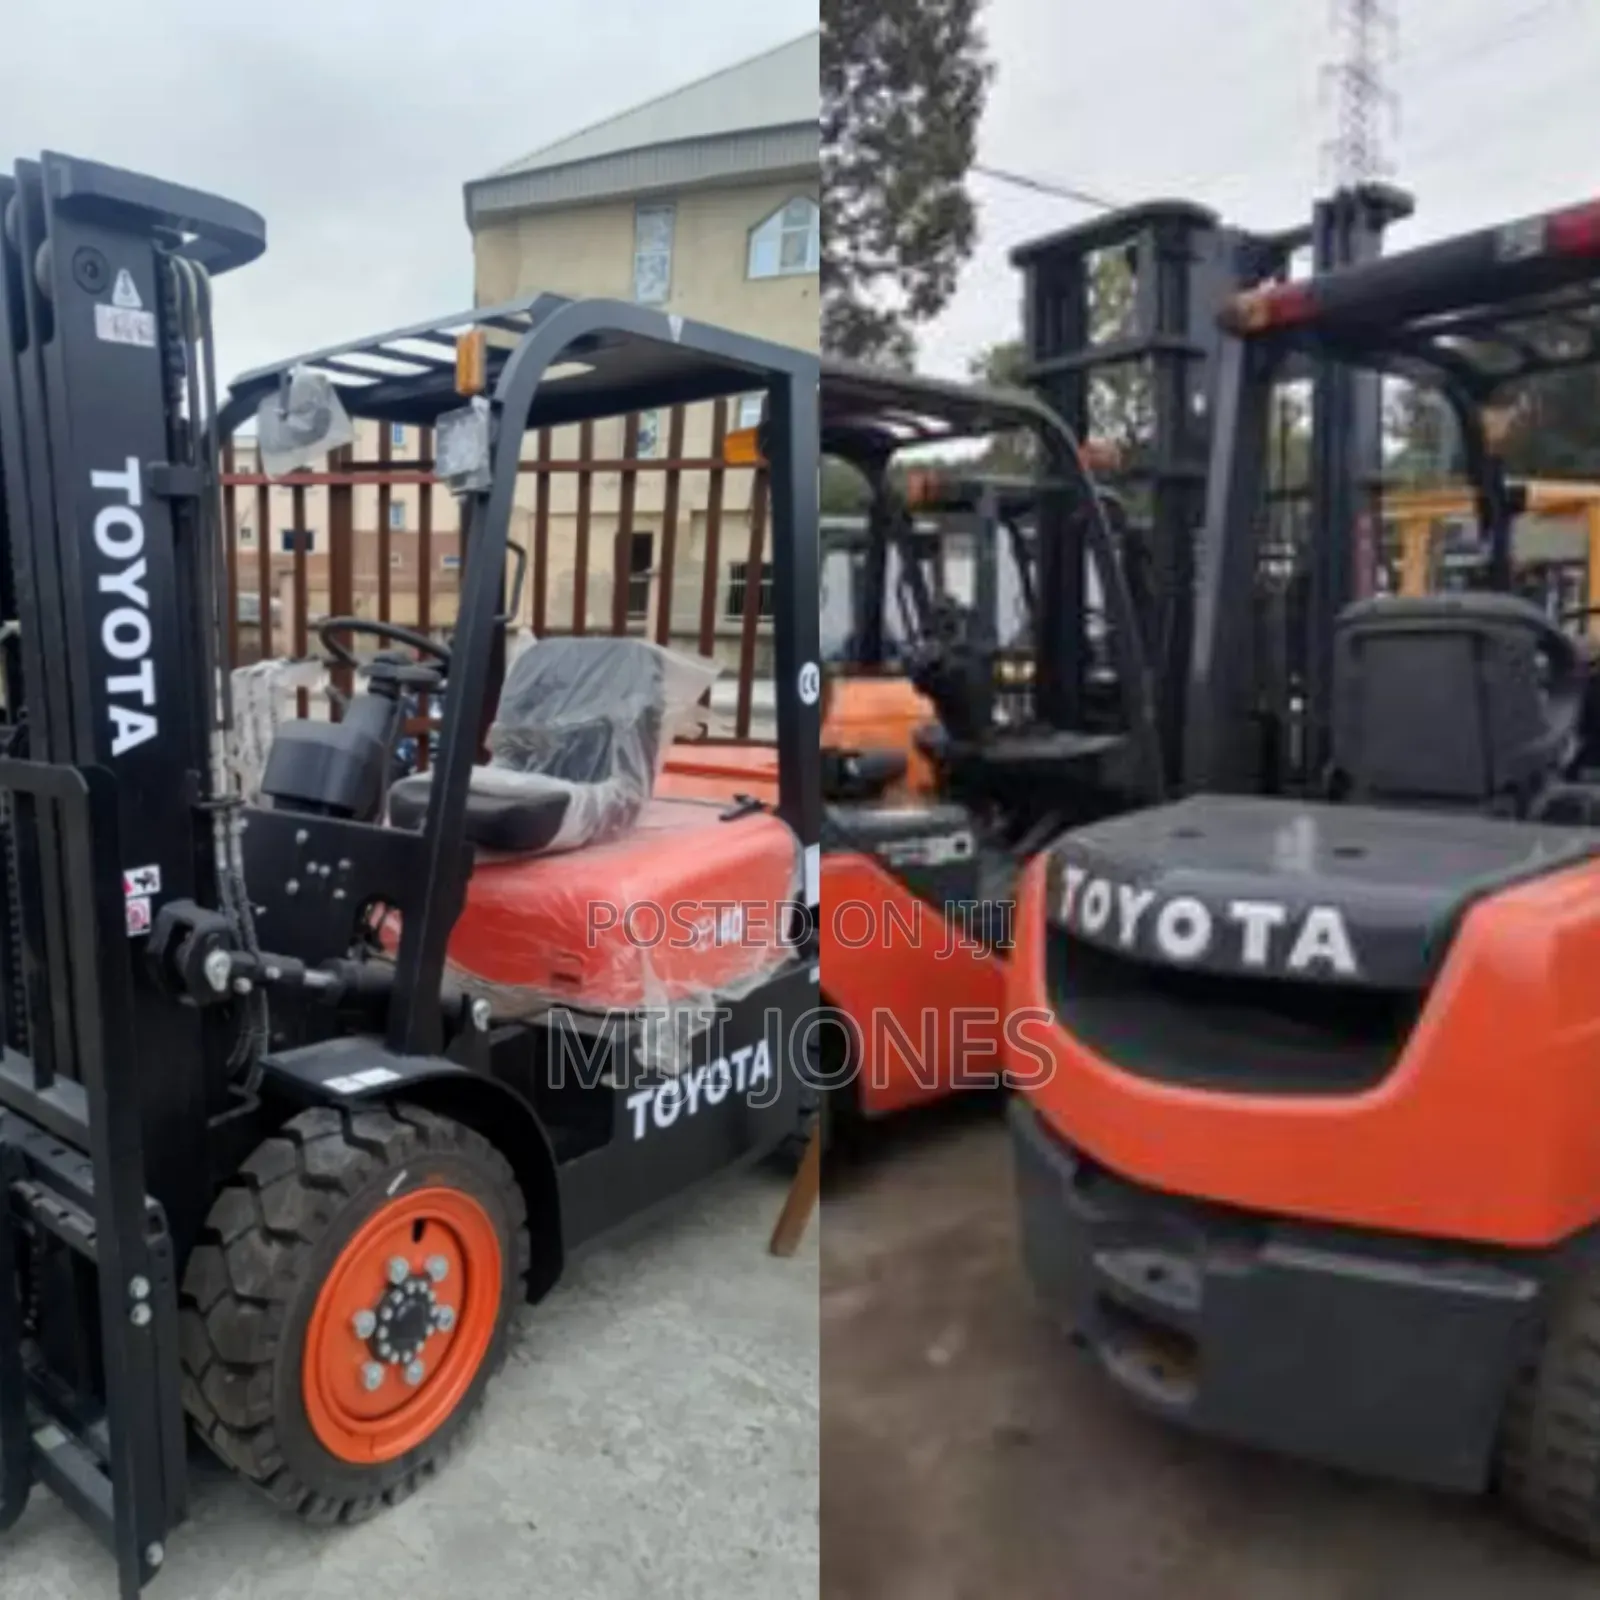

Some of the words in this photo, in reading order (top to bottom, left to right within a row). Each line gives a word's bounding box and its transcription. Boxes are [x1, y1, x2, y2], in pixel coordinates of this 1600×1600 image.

[90, 456, 158, 757] TOYOTA
[1060, 863, 1357, 975] TOYOTA
[626, 1038, 772, 1141] TOYOTA
